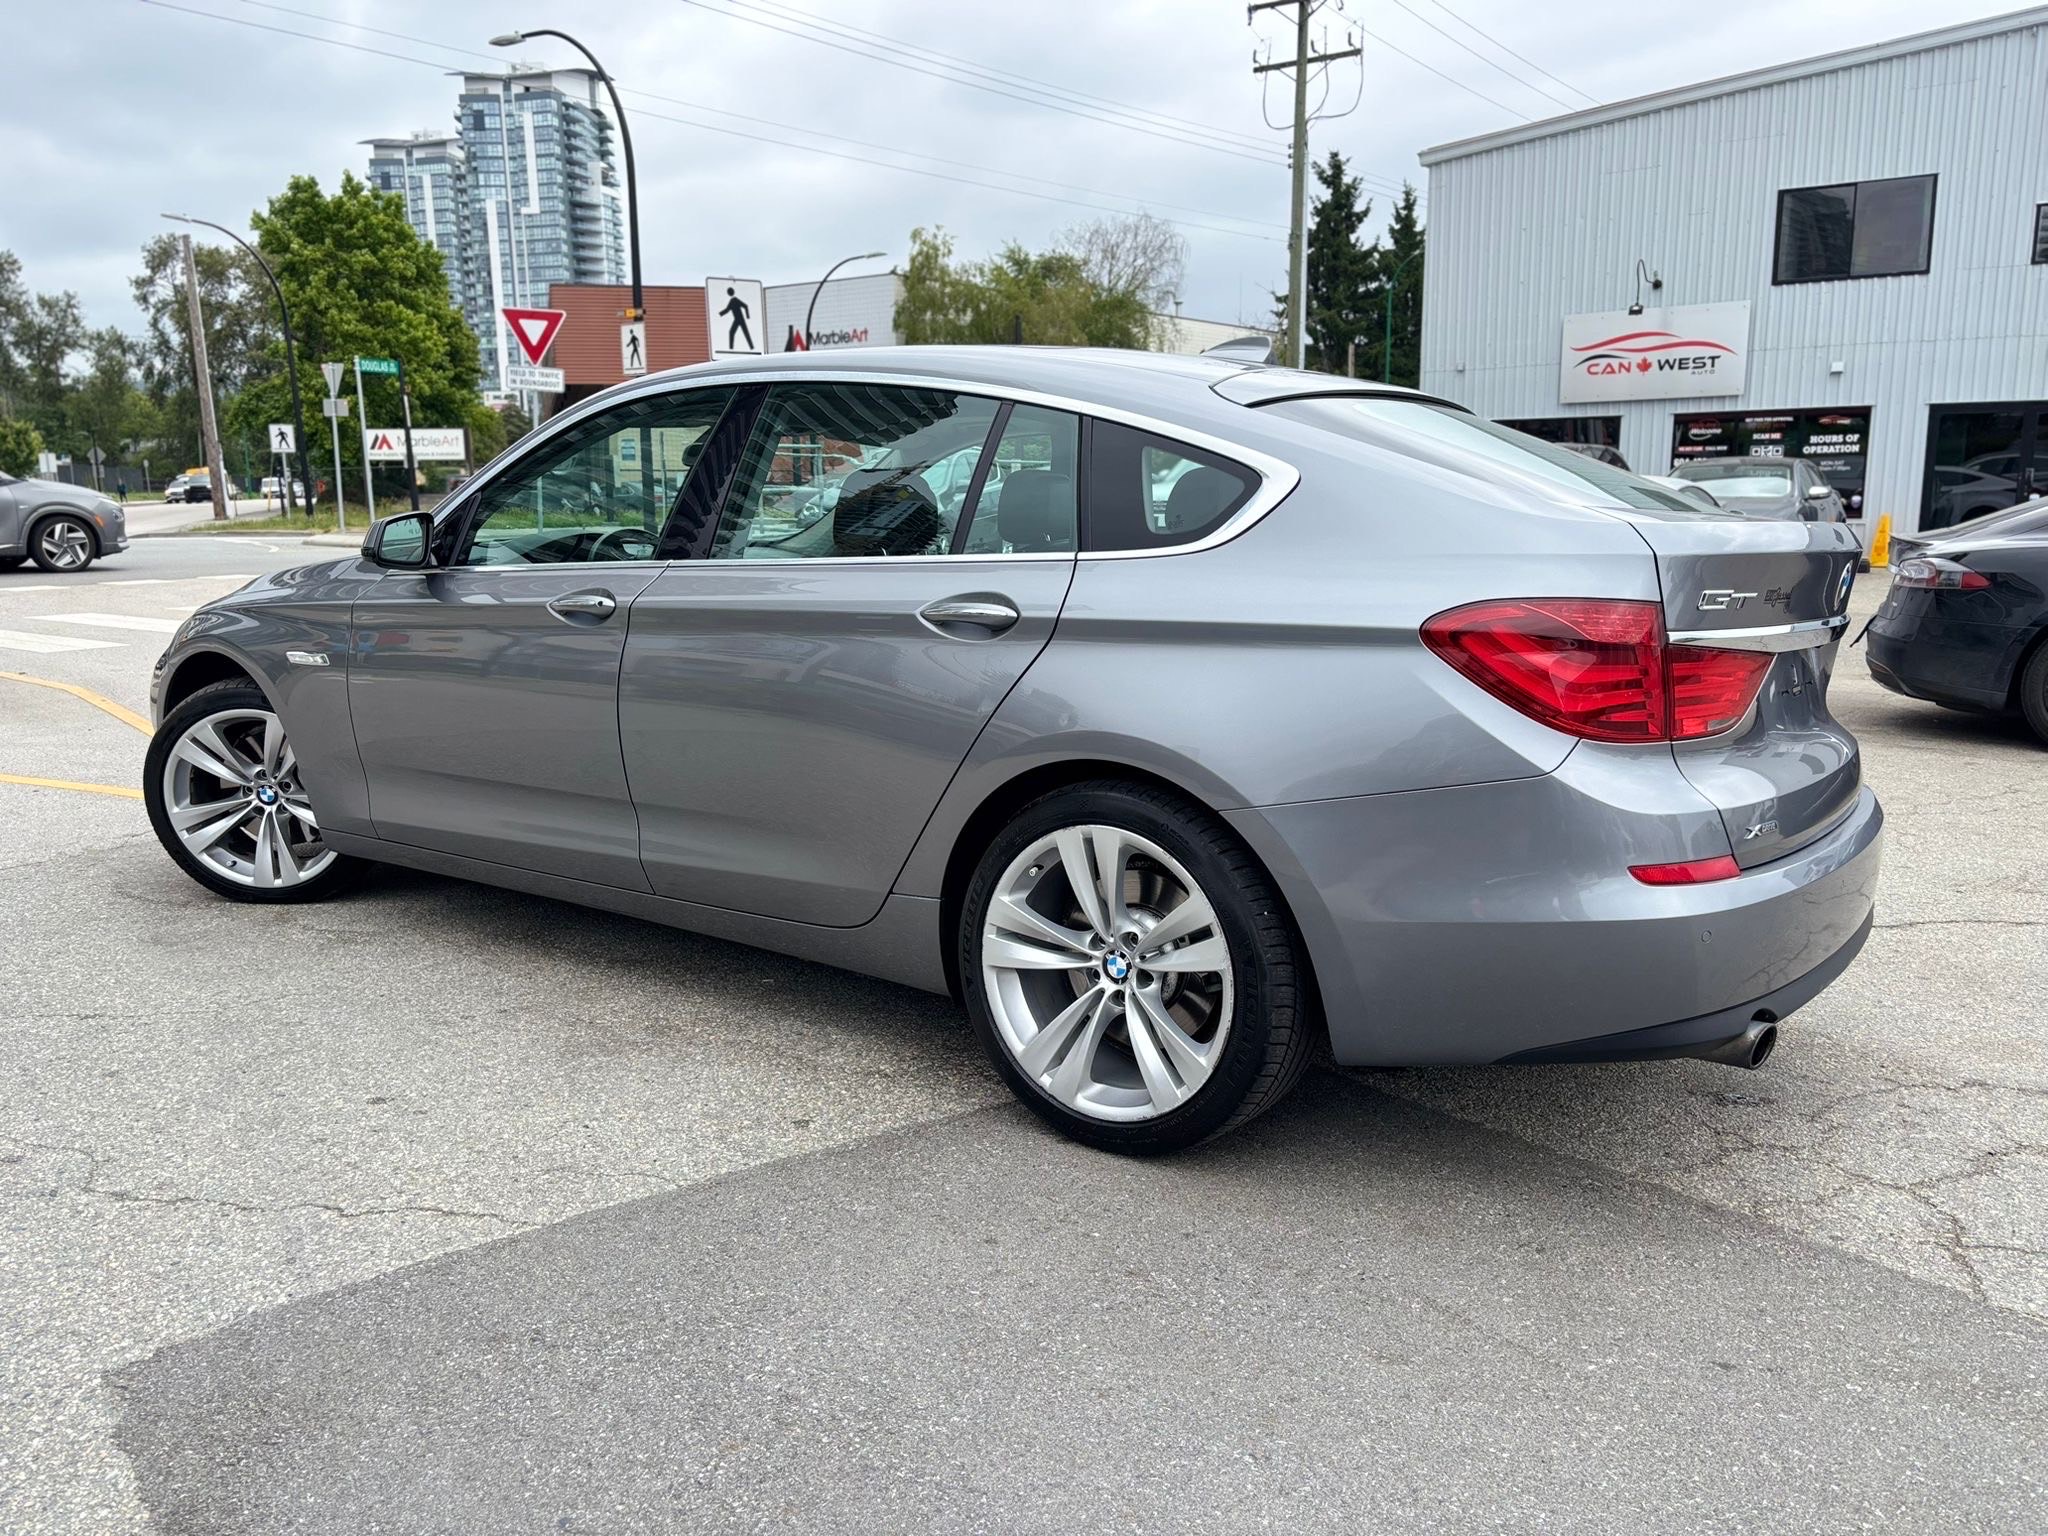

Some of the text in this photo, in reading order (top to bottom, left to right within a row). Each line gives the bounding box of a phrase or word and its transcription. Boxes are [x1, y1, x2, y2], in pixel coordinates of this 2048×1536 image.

[808, 328, 868, 345] MarbleArt
[361, 360, 389, 372] DOUGLAS
[1587, 355, 1721, 375] CAN WEST
[510, 369, 526, 377] YIELD
[538, 371, 560, 379] TRAFFIC
[1810, 434, 1860, 444] HOURS OF
[1803, 444, 1860, 454] OPERATION
[1698, 589, 1758, 611] GT
